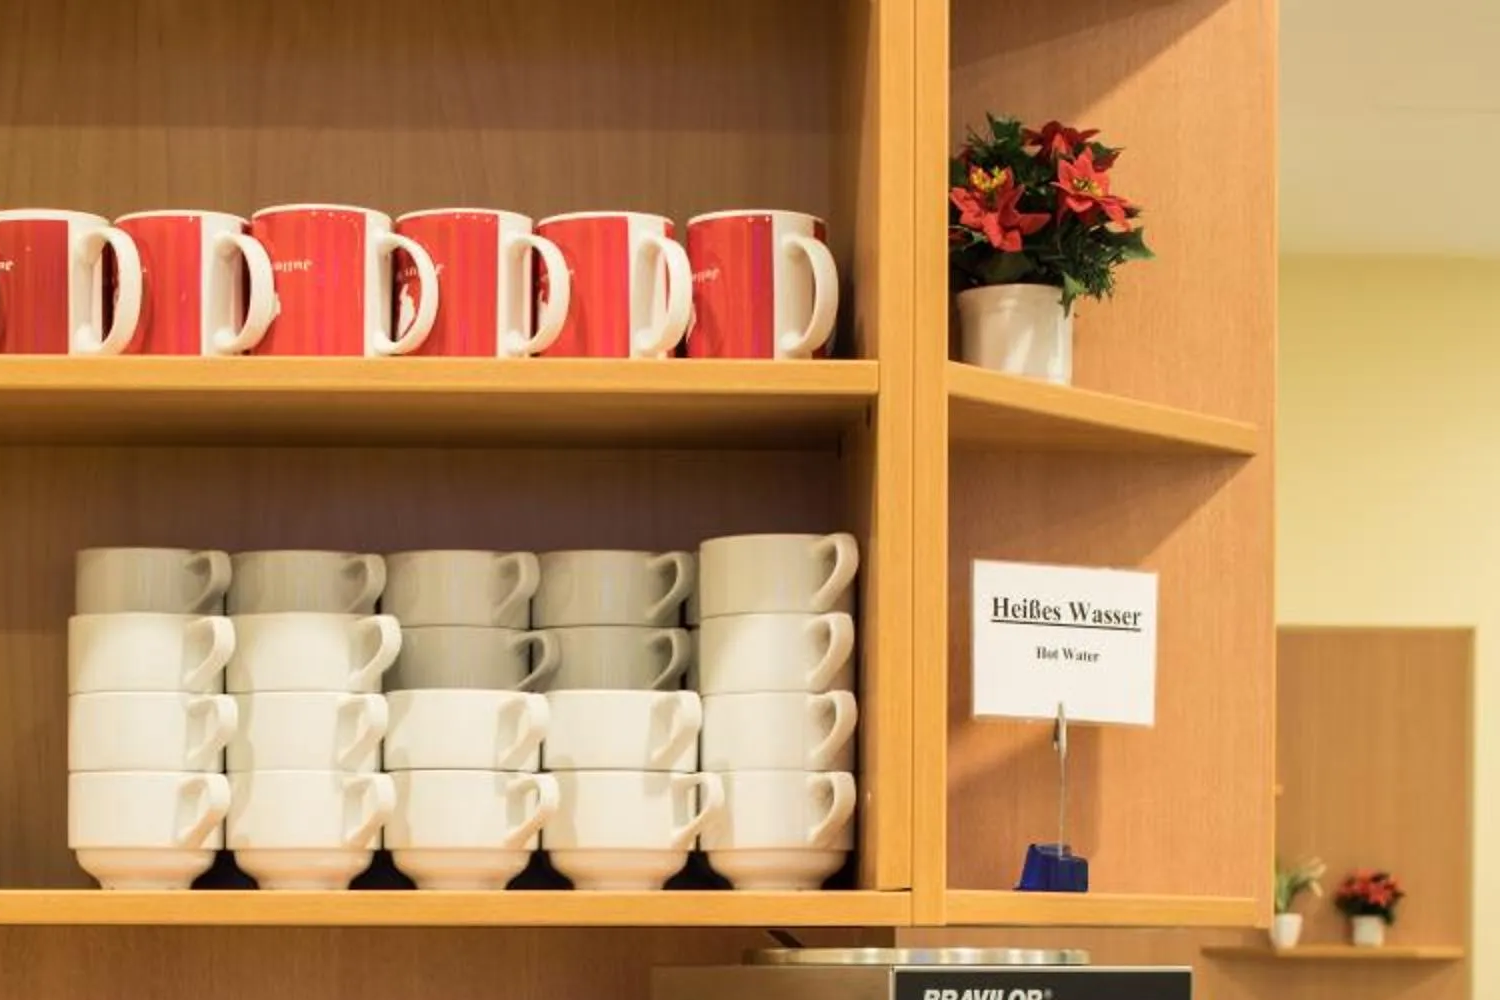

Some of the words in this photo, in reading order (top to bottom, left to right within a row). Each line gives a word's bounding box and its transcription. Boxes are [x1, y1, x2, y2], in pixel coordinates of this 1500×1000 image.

[991, 596, 1062, 621] Heißes
[1069, 600, 1143, 626] Wasser
[1036, 646, 1059, 660] Hot
[1062, 647, 1100, 663] Water
